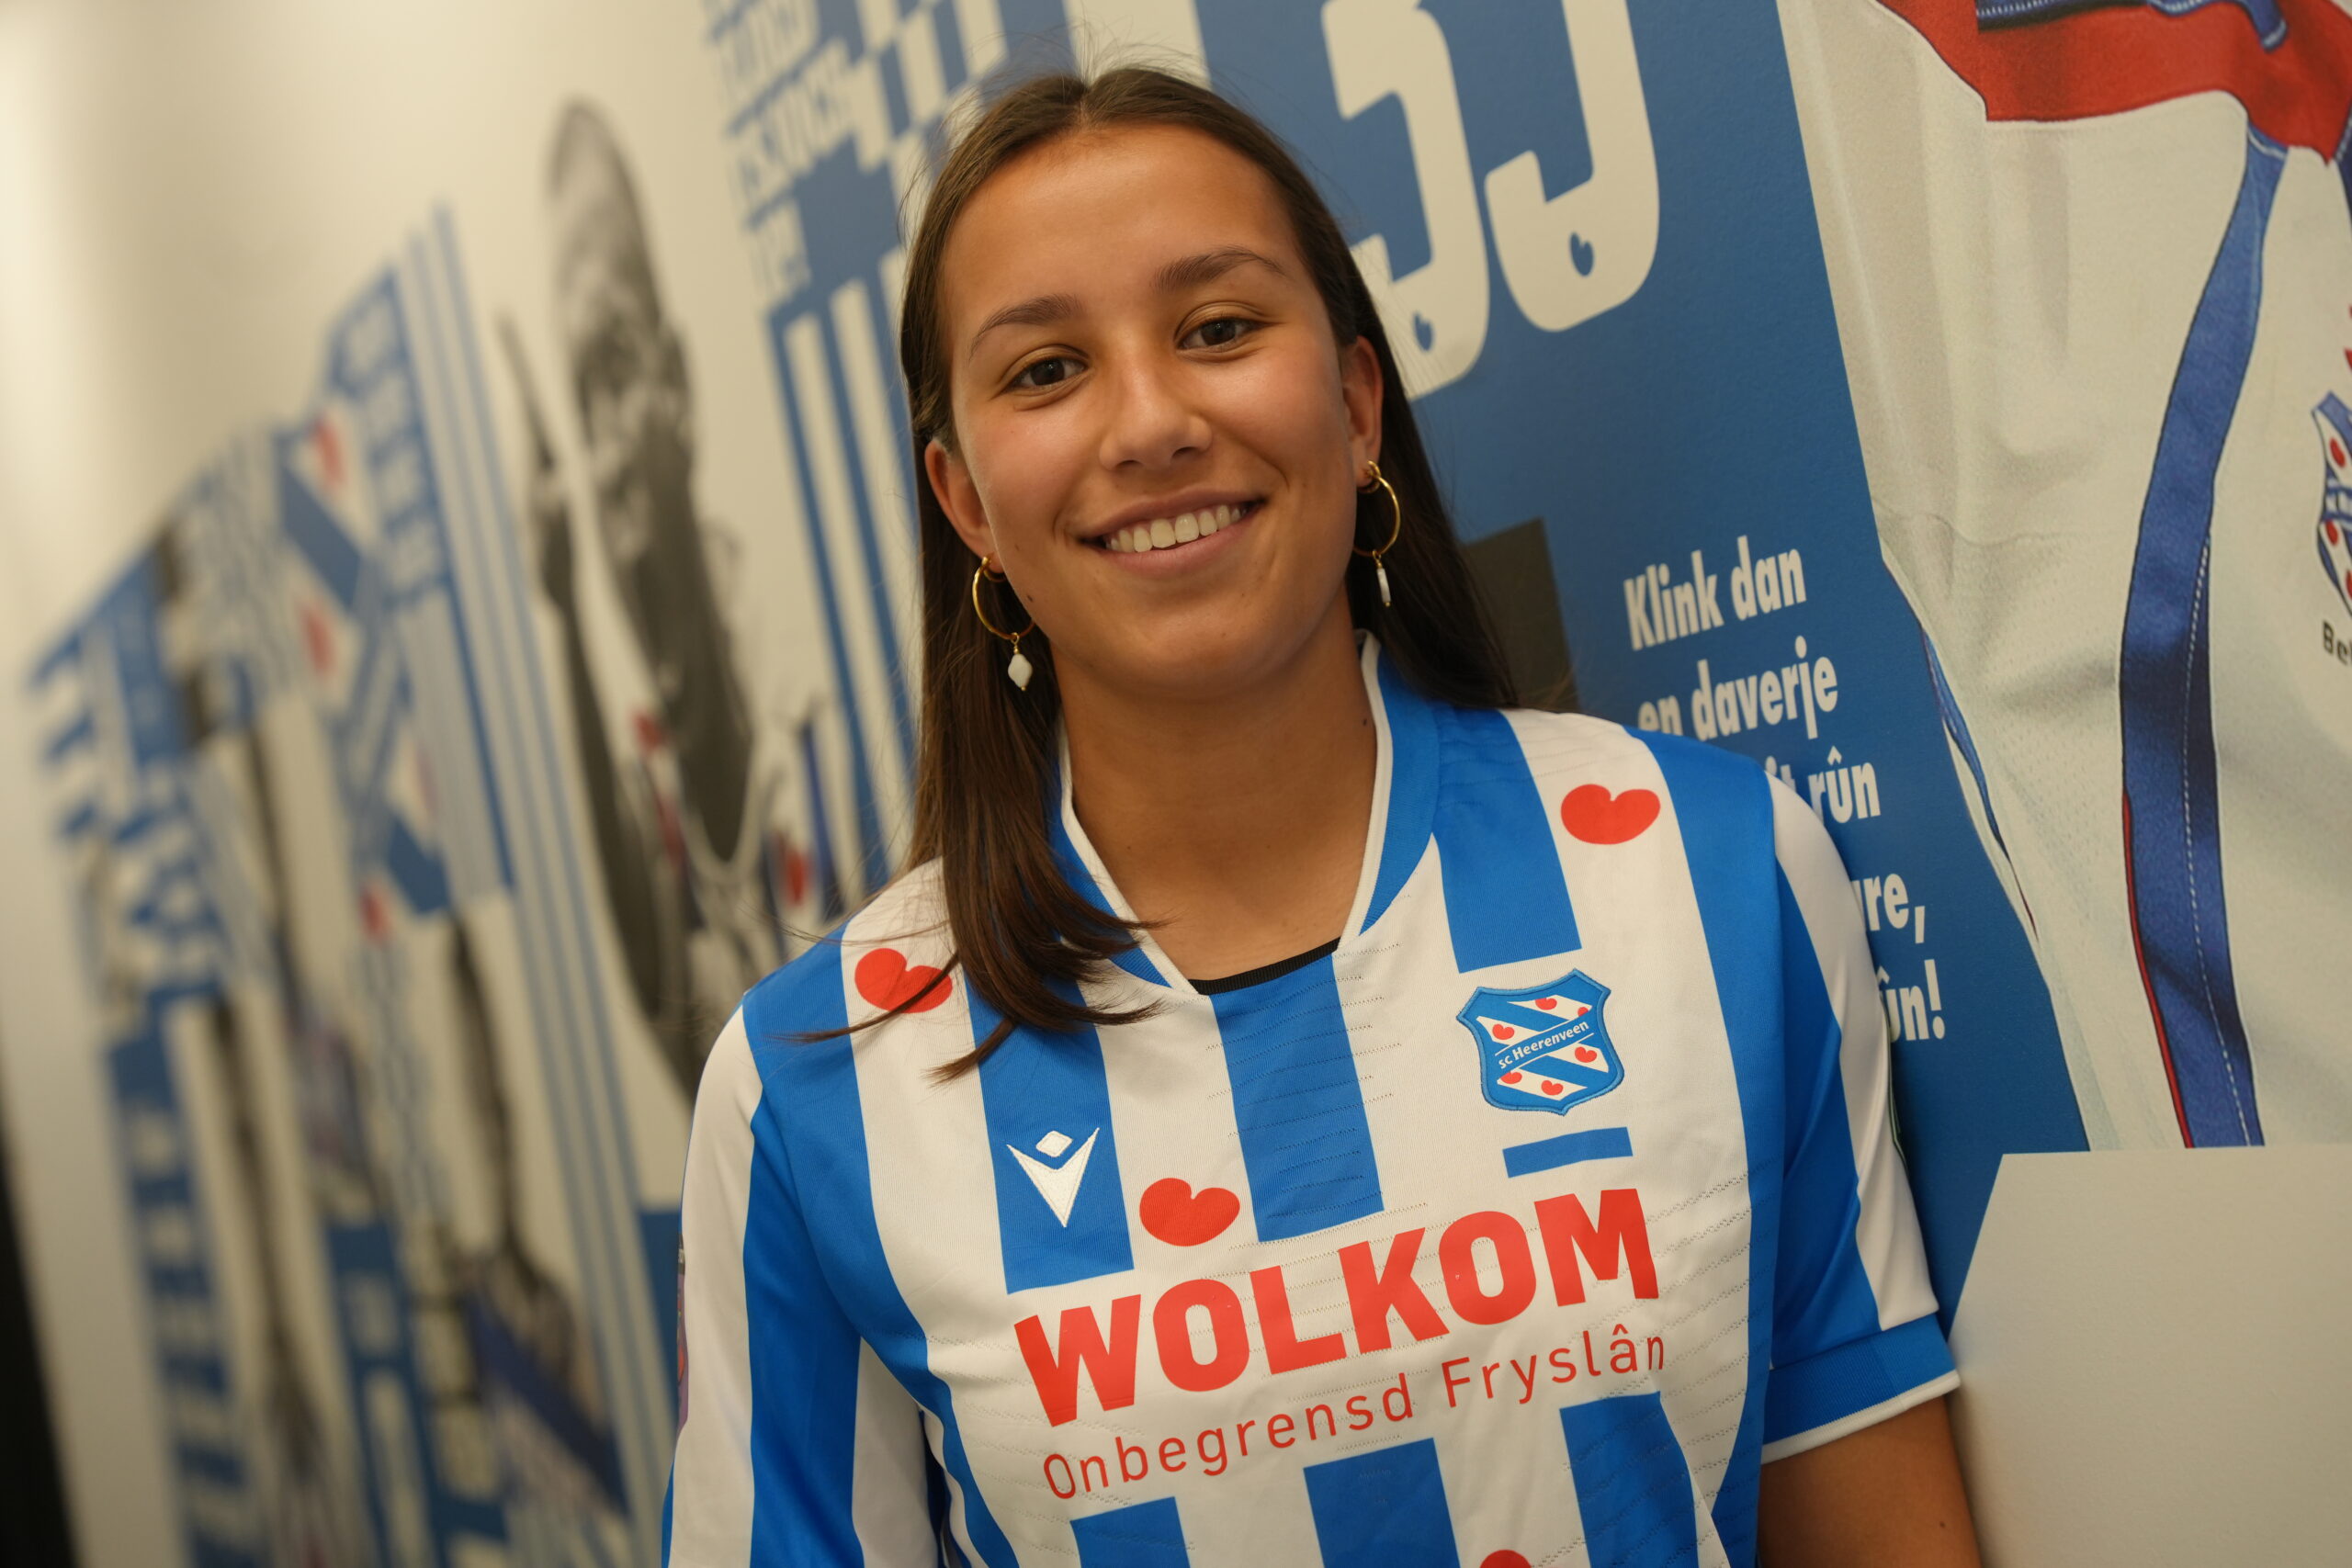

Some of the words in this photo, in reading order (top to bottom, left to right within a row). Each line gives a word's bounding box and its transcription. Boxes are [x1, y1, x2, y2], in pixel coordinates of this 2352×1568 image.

[1623, 549, 1724, 650] Klink
[1730, 536, 1806, 620] dan
[2323, 620, 2352, 668] Be
[1691, 636, 1838, 739] daverje
[1807, 746, 1881, 823] rûn
[1512, 1021, 1589, 1061] Heerenveen
[1013, 1188, 1659, 1427] WOLKOM
[1043, 1372, 1414, 1500] Onbegrensd
[1442, 1323, 1665, 1407] Fryslân
